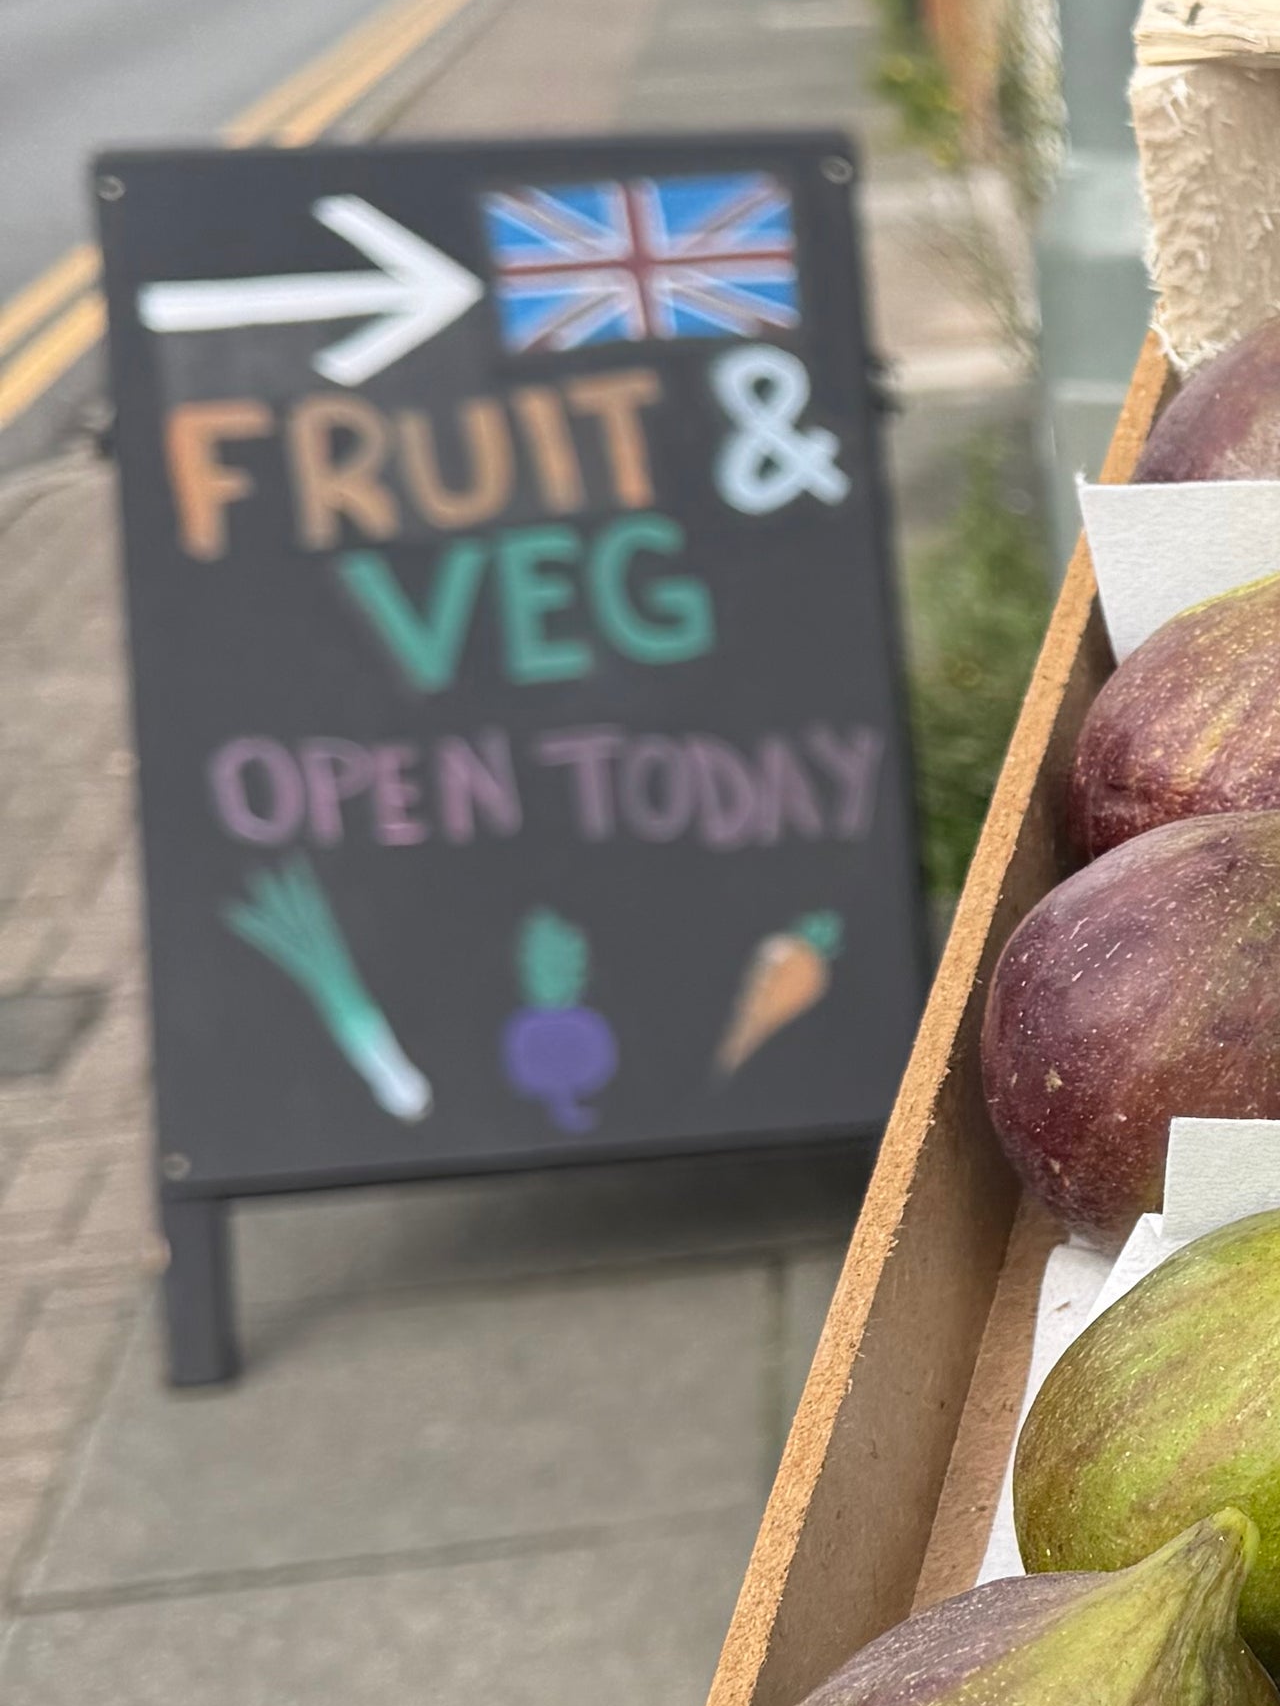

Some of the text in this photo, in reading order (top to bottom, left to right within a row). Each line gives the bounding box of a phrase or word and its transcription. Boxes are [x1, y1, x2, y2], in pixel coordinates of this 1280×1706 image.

[166, 346, 849, 558] FRUIT &
[341, 516, 713, 688] VEG
[212, 725, 884, 847] OPEN TODAY
